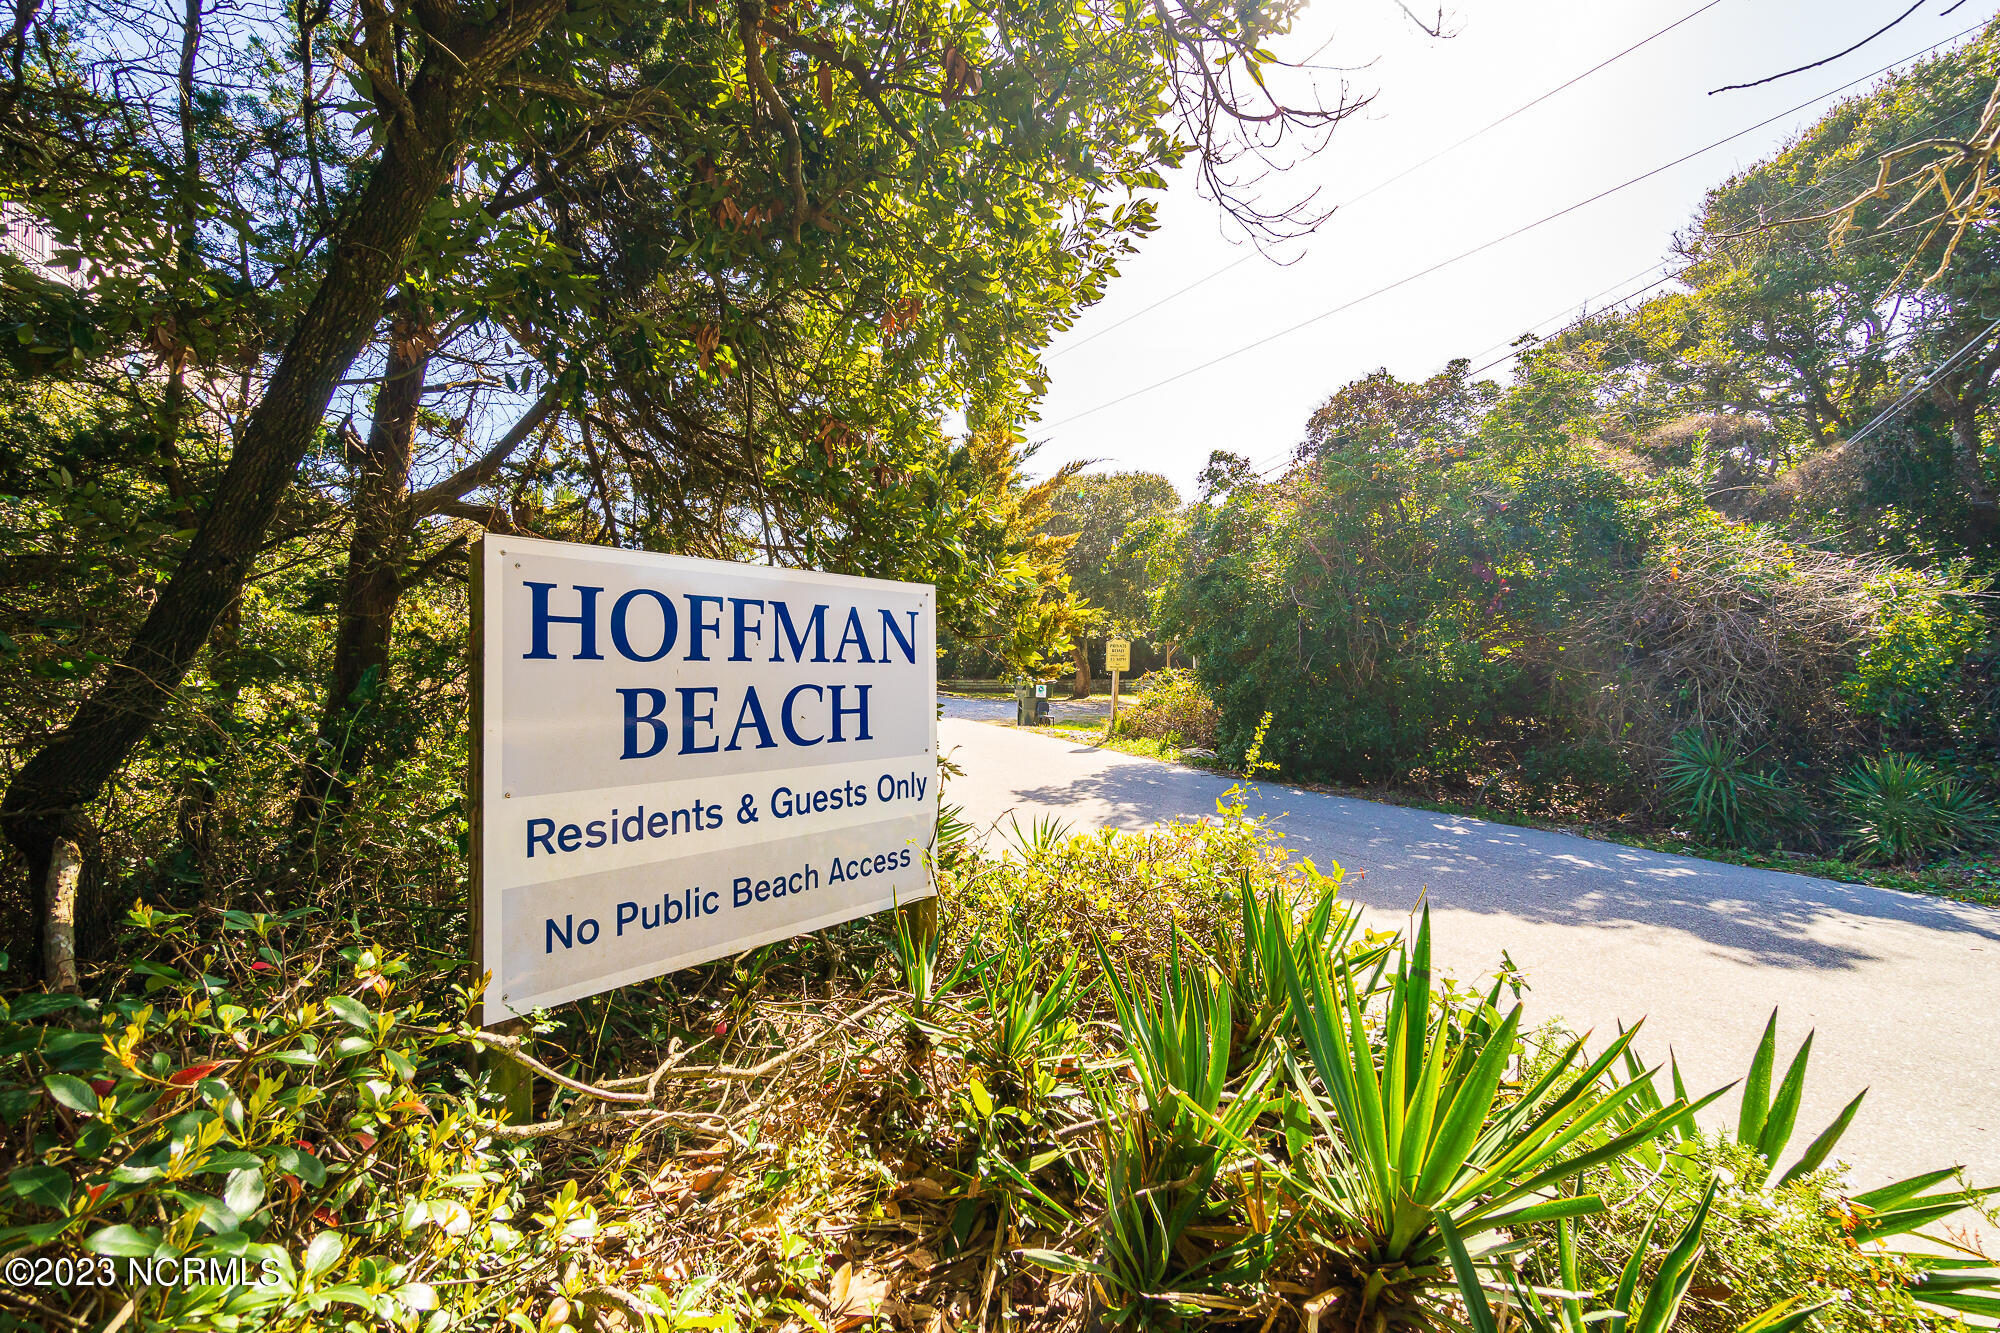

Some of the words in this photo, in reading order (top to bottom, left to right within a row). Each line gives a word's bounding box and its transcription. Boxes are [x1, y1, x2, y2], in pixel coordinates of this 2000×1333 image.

[522, 580, 919, 665] HOFFMAN
[615, 684, 873, 760] BEACH
[526, 799, 723, 858] Residents
[736, 793, 759, 825] &
[771, 779, 867, 819] Guests
[877, 771, 928, 802] Only
[545, 914, 600, 954] No
[616, 888, 720, 936] Public
[732, 863, 819, 908] Beach
[829, 847, 912, 886] Access
